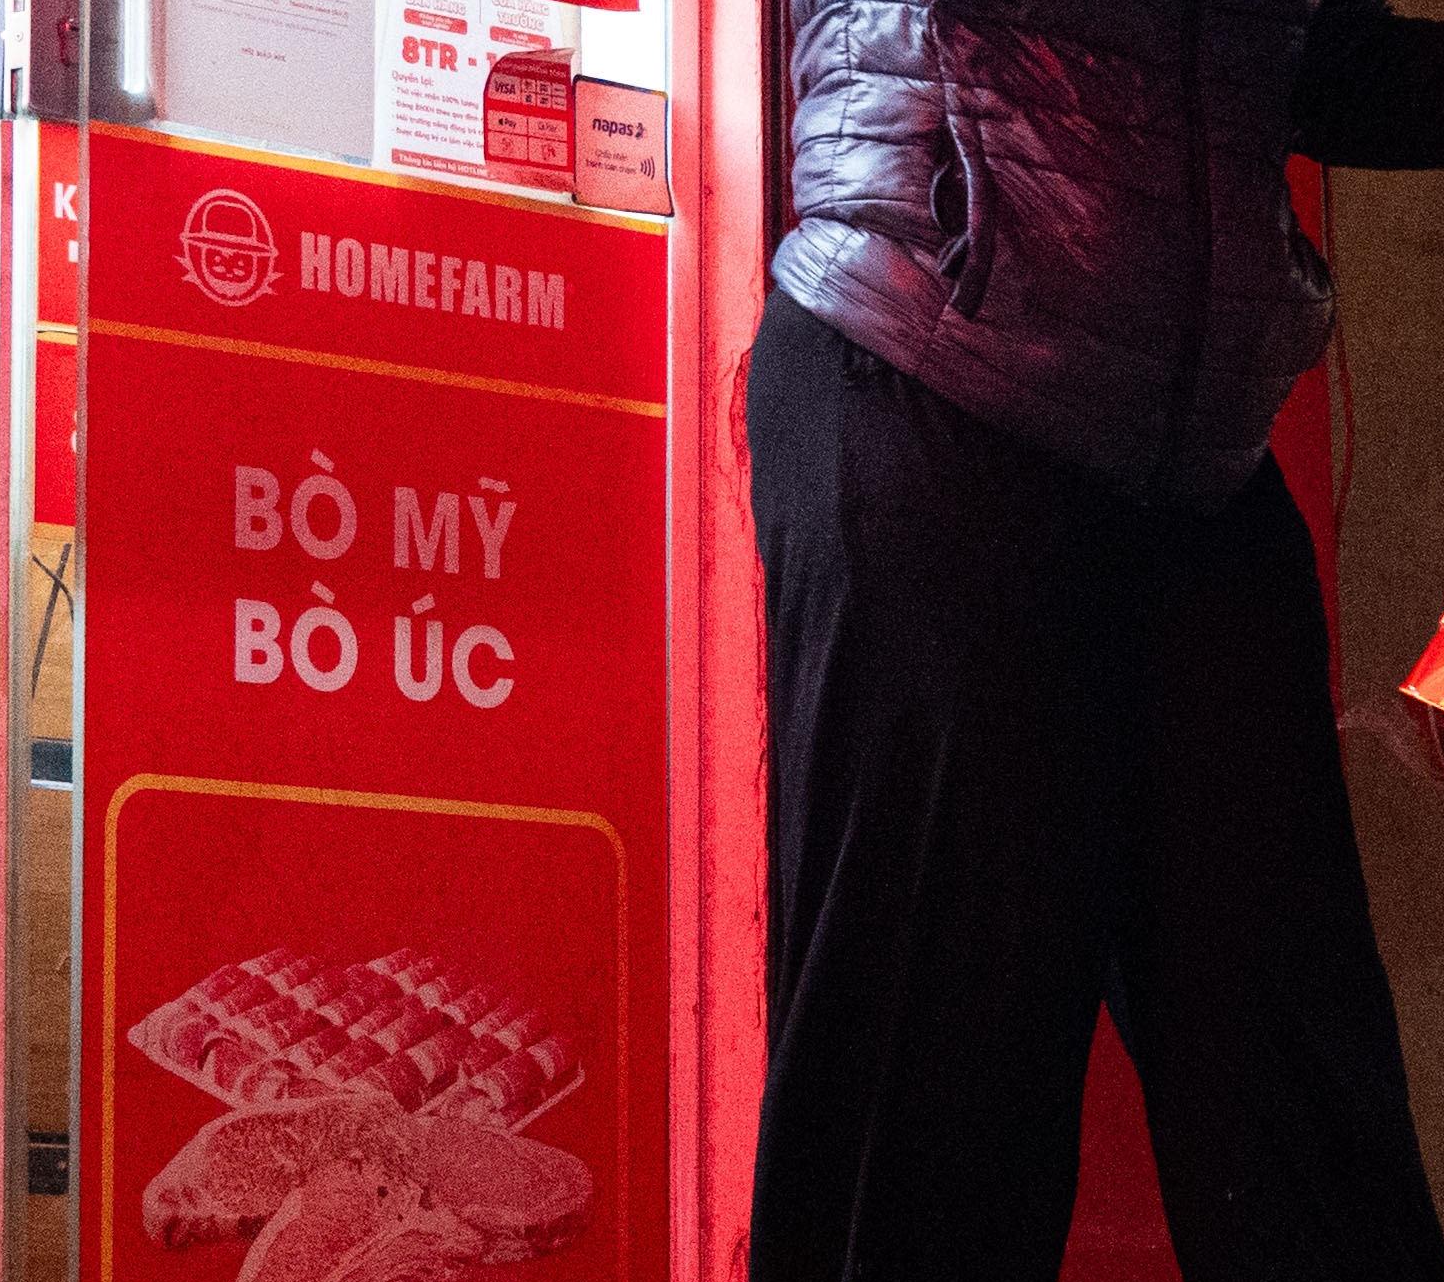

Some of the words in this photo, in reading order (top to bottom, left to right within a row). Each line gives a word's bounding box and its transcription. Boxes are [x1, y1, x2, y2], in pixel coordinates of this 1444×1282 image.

[402, 35, 458, 72] 8TR
[494, 79, 516, 96] VISA
[592, 117, 634, 139] napas
[298, 231, 567, 332] HOMEFARM
[234, 449, 358, 561] BÒ
[393, 476, 517, 580] MỸ
[234, 581, 358, 693] BÒ
[393, 593, 515, 709] ÚC
